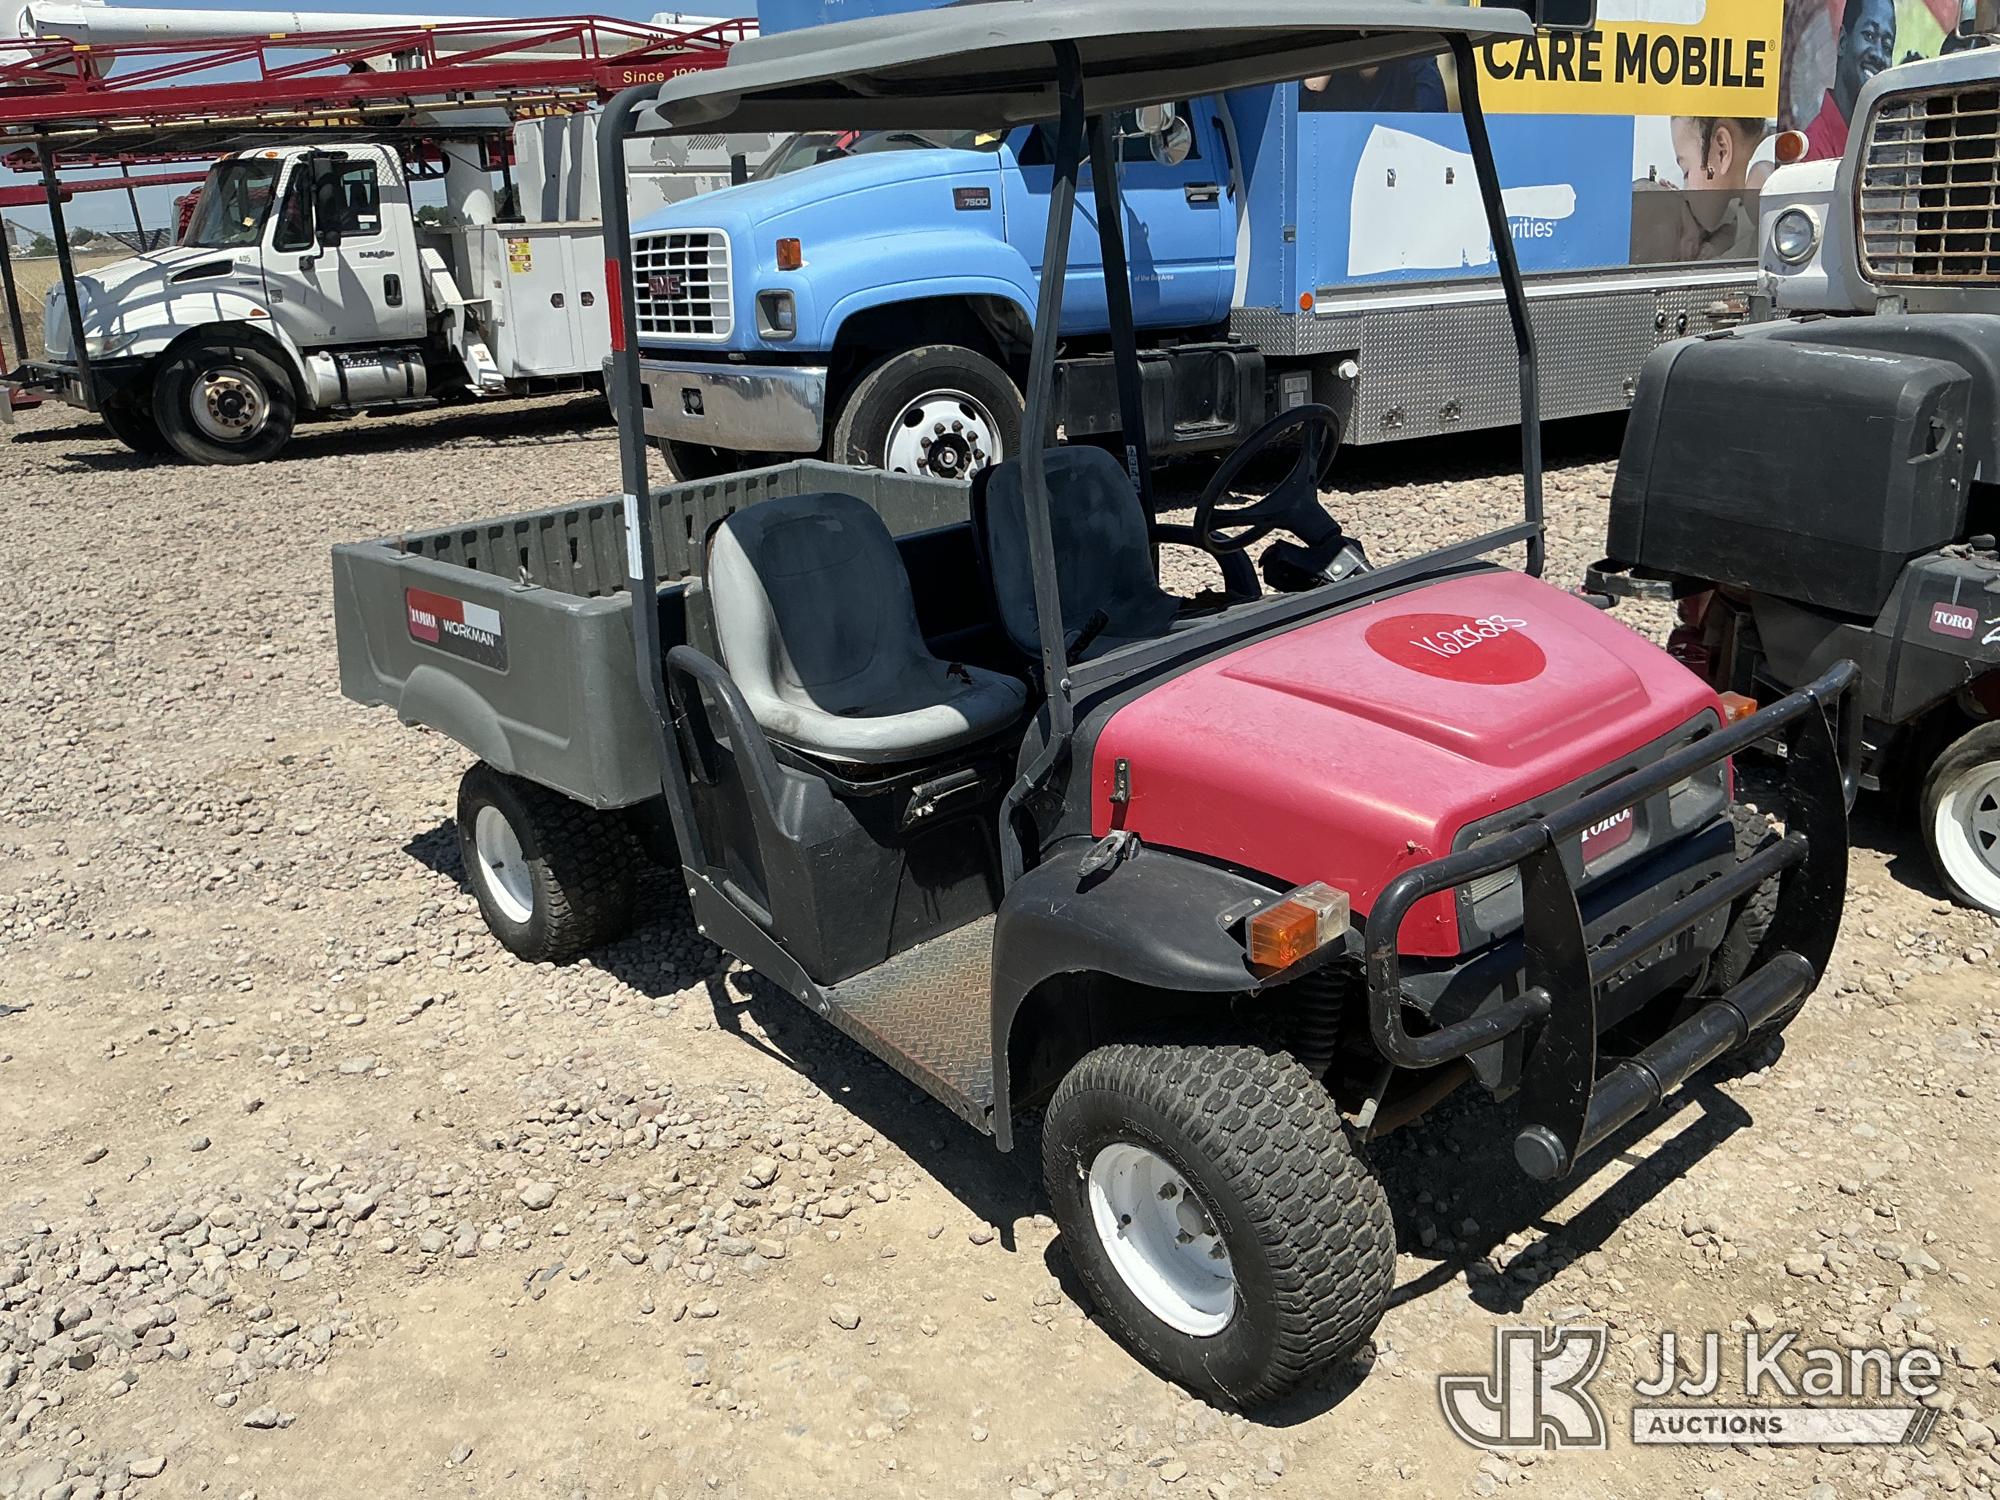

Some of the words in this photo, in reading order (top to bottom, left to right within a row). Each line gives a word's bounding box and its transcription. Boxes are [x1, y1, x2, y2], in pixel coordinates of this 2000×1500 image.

[1482, 31, 1602, 82] CARE
[623, 71, 665, 83] Since
[1508, 217, 1557, 239] rities
[649, 274, 681, 295] GMC
[1934, 610, 1973, 631] TORO
[442, 618, 495, 647] WORKMAN
